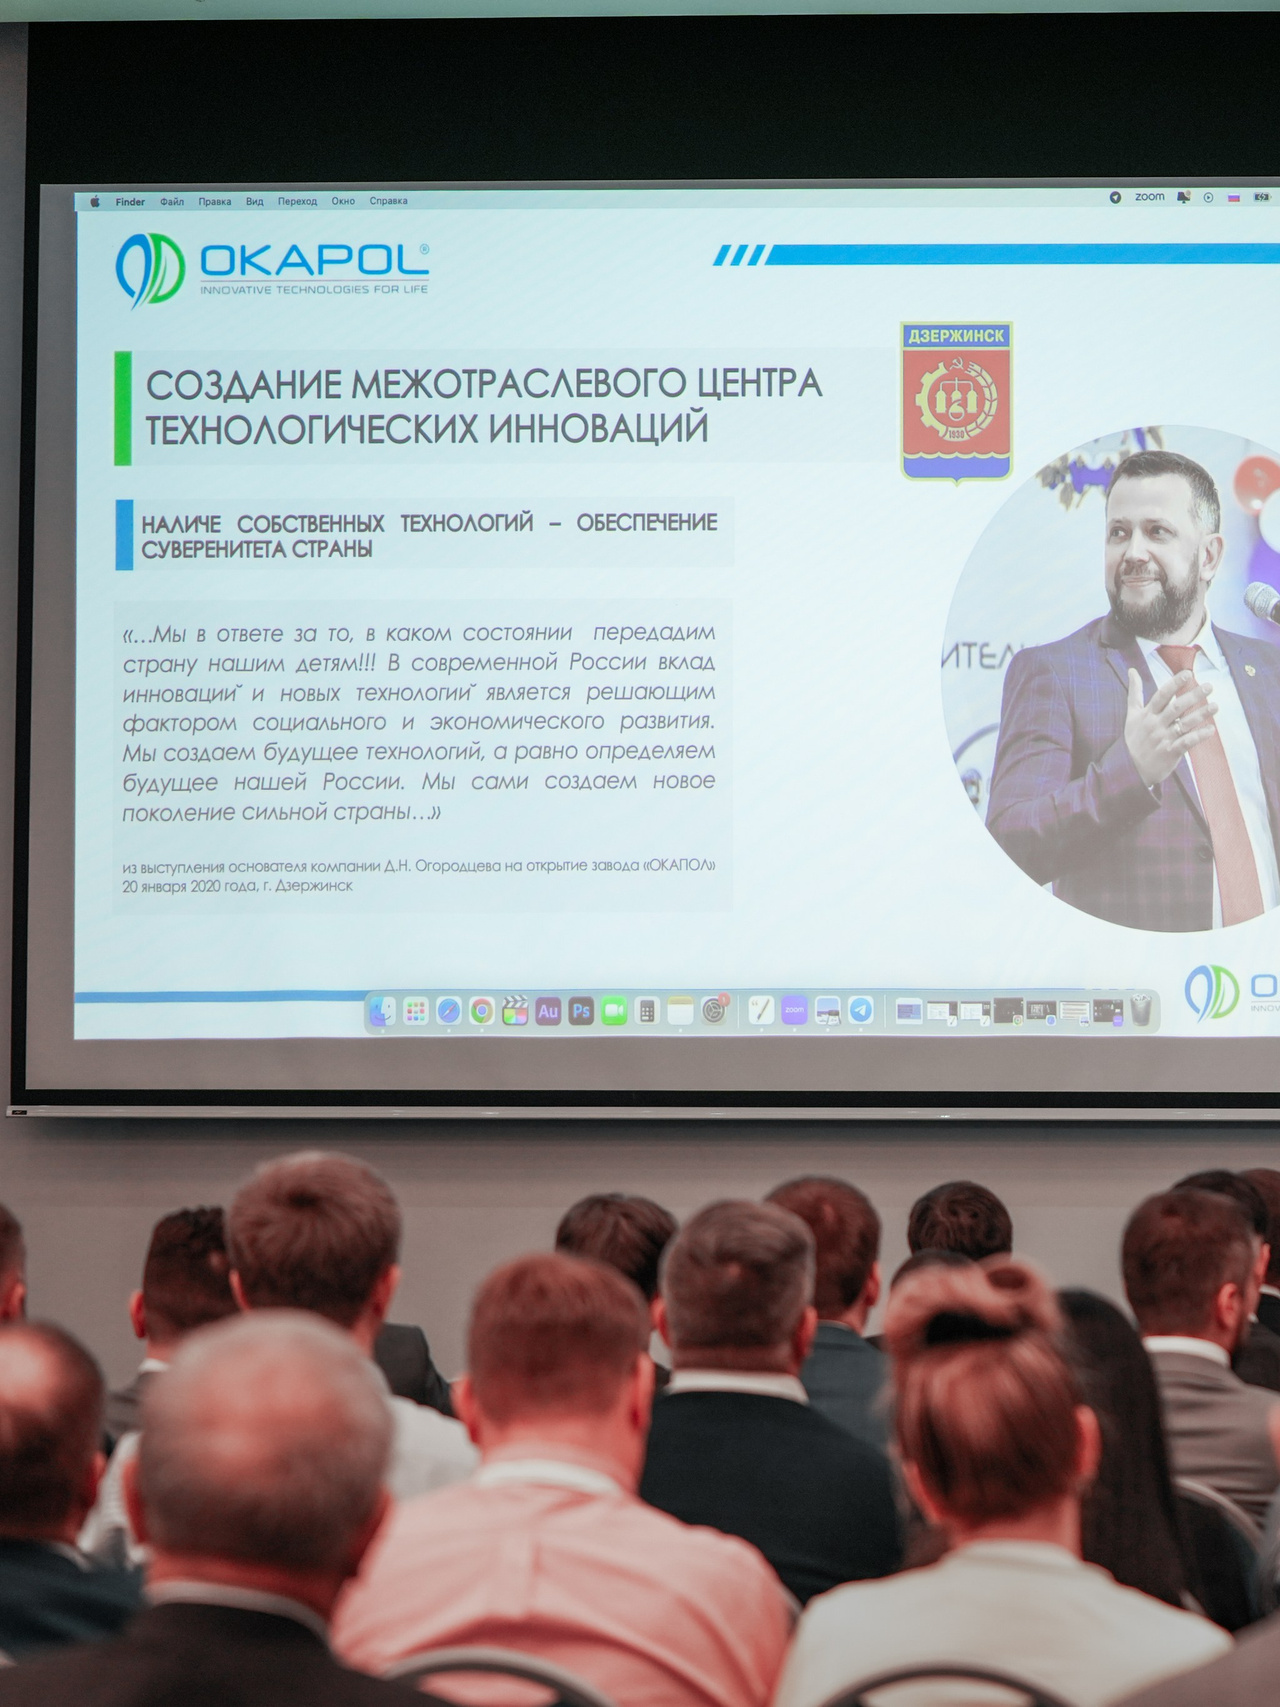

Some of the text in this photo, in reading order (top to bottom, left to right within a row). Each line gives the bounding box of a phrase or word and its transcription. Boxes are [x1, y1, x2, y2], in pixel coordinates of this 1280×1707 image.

[115, 196, 408, 208] Finder Файл Правка Вид Переход Окно Справка
[1135, 193, 1165, 202] zoom
[200, 284, 428, 295] INNOVATIVE TECHNOLOGIES FOR LIFE
[908, 328, 1005, 344] ДЗЕРЖИНСК
[146, 367, 824, 404] СОЗДАНИЕ МЕЖОТРАСЛЕВОГО ЦЕНТРА
[145, 406, 708, 447] ТЕХНОЛОГИЧЕСКИХ ИННОВАЦИЙ
[948, 429, 965, 440] 1930
[142, 514, 222, 534] НАЛИЧЕ
[237, 514, 385, 534] СОБСТВЕННЫХ
[400, 509, 534, 533] ТЕХНОЛОГИЙ
[576, 512, 718, 532] ОБЕСПЕЧЕНИЕ
[141, 539, 373, 560] СУВЕРЕНИТЕТА СТРАНЫ
[196, 628, 206, 643] в
[216, 627, 284, 643] ответе
[293, 627, 318, 643] за
[328, 627, 354, 644] то,
[365, 627, 376, 642] в
[386, 627, 452, 642] каком
[462, 626, 573, 642] состоянии
[593, 625, 716, 645] передадим
[123, 651, 716, 678] страну нашим детям!!! В современной России вклад
[251, 687, 265, 702] и
[280, 687, 341, 703] новых
[485, 685, 571, 701] является
[586, 685, 716, 705] решающим
[122, 713, 715, 737] фактором социального и экономического развития.
[122, 740, 716, 766] Мы создаем будущее технологий, а равно определяем
[122, 771, 716, 797] будущее нашей России. Мы сами создаем новое
[122, 806, 236, 823] поколение
[242, 801, 328, 821] сильной
[122, 857, 716, 877] из выступления основателя компании Д.Н. Огородцева на открытие завода «ОКАПОЛ»
[122, 878, 353, 896] 20 января 2020 года, г. Дзержинск
[538, 1004, 558, 1019] Au
[573, 1004, 590, 1019] Ps
[785, 1006, 804, 1014] zoom
